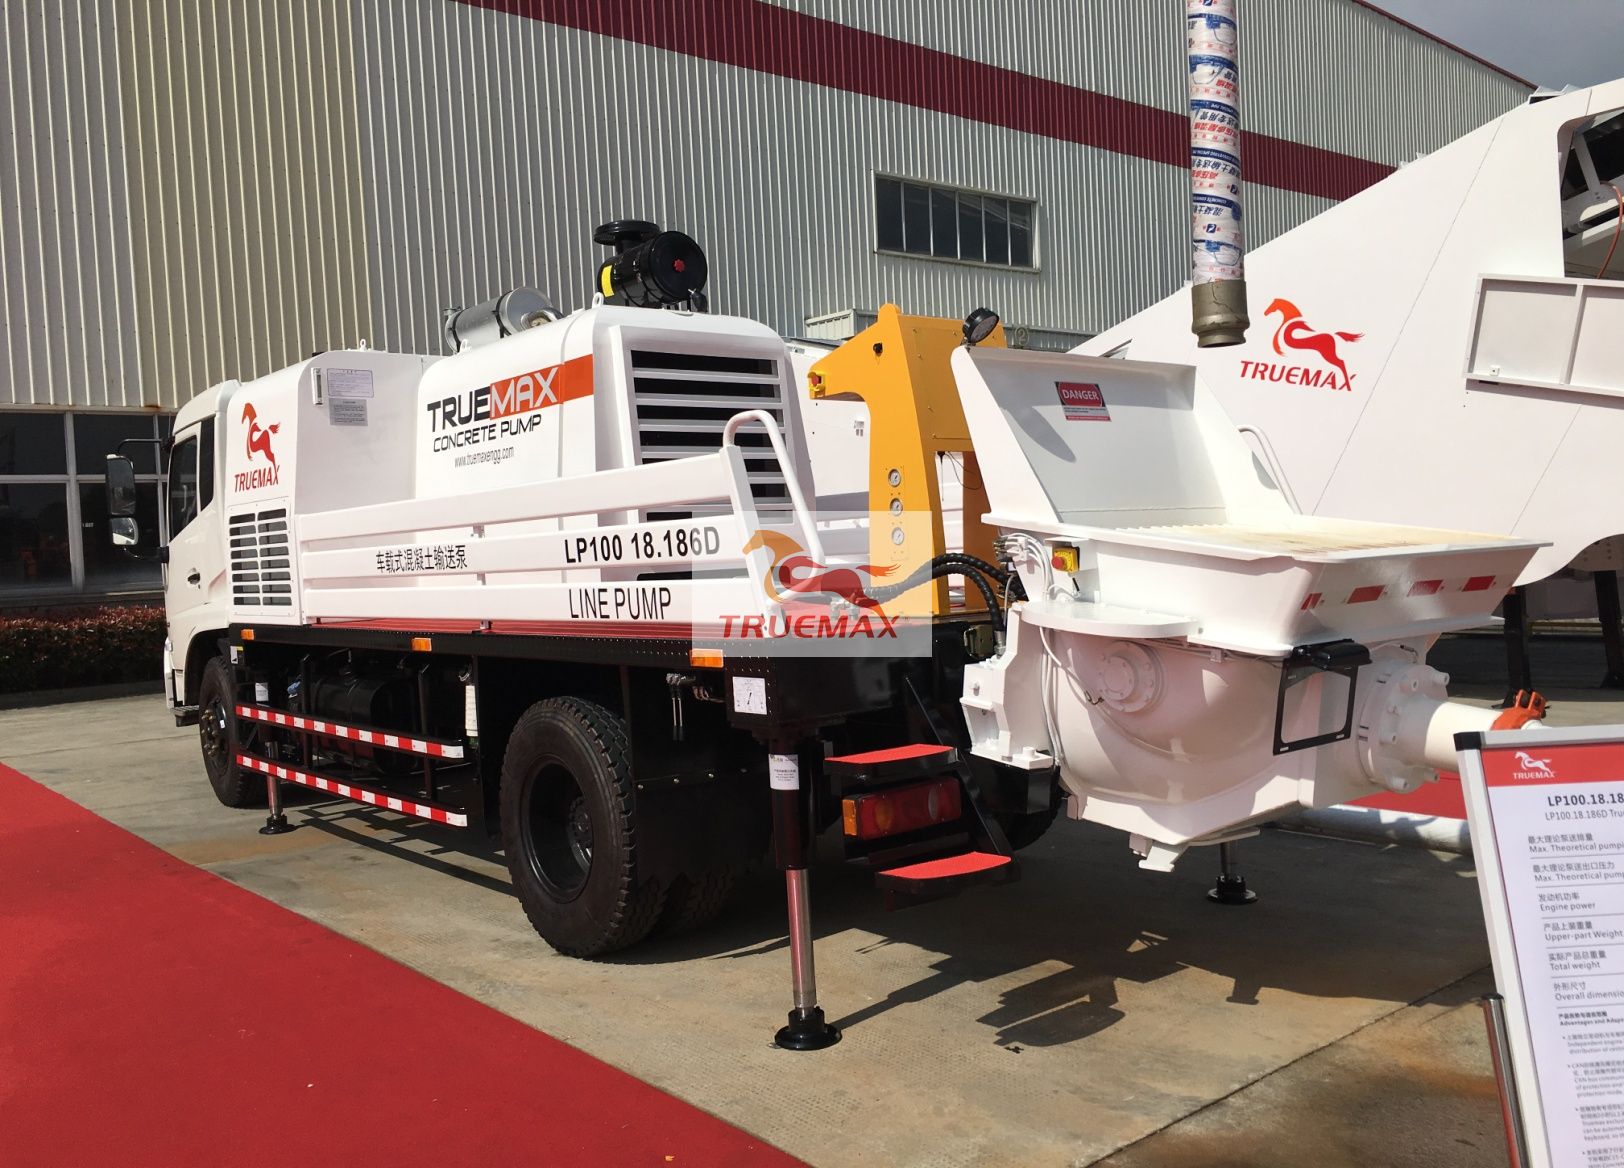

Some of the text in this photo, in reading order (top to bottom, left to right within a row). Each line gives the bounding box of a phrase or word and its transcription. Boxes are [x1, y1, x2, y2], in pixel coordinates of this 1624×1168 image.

[1240, 360, 1357, 391] TRUEMAX
[427, 367, 559, 432] TRUEMAX
[1062, 389, 1099, 400] DANGER
[433, 413, 542, 453] CONCRETE PUMP
[454, 446, 515, 468] www.truemaxengg.com
[234, 465, 280, 493] TRUEMAX
[564, 526, 720, 564] LP100 18.186D
[376, 545, 467, 573] 车载式混凝土输送泵
[569, 587, 671, 620] LINE PUMP
[1513, 771, 1556, 780] TRUEMAX
[1545, 809, 1607, 821] LP100.18.186D
[1528, 832, 1594, 844] 最大理论泵送排量
[1529, 845, 1549, 853] Max.
[1551, 842, 1597, 852] Theoretical
[1533, 861, 1615, 873] 最大理论泵送出口压力
[1534, 874, 1555, 882] Max.
[1556, 872, 1602, 881] Theoretical
[1538, 892, 1580, 902] 发动机功率
[1540, 902, 1596, 912] Engine power
[1543, 920, 1593, 932] 产品上装重量
[1544, 929, 1623, 942] Upper-part Weight
[1549, 950, 1607, 961] 实际产品总重量
[1550, 960, 1601, 971] Total weight
[1553, 981, 1586, 991] 外形尺寸
[1555, 992, 1585, 1001] Overall
